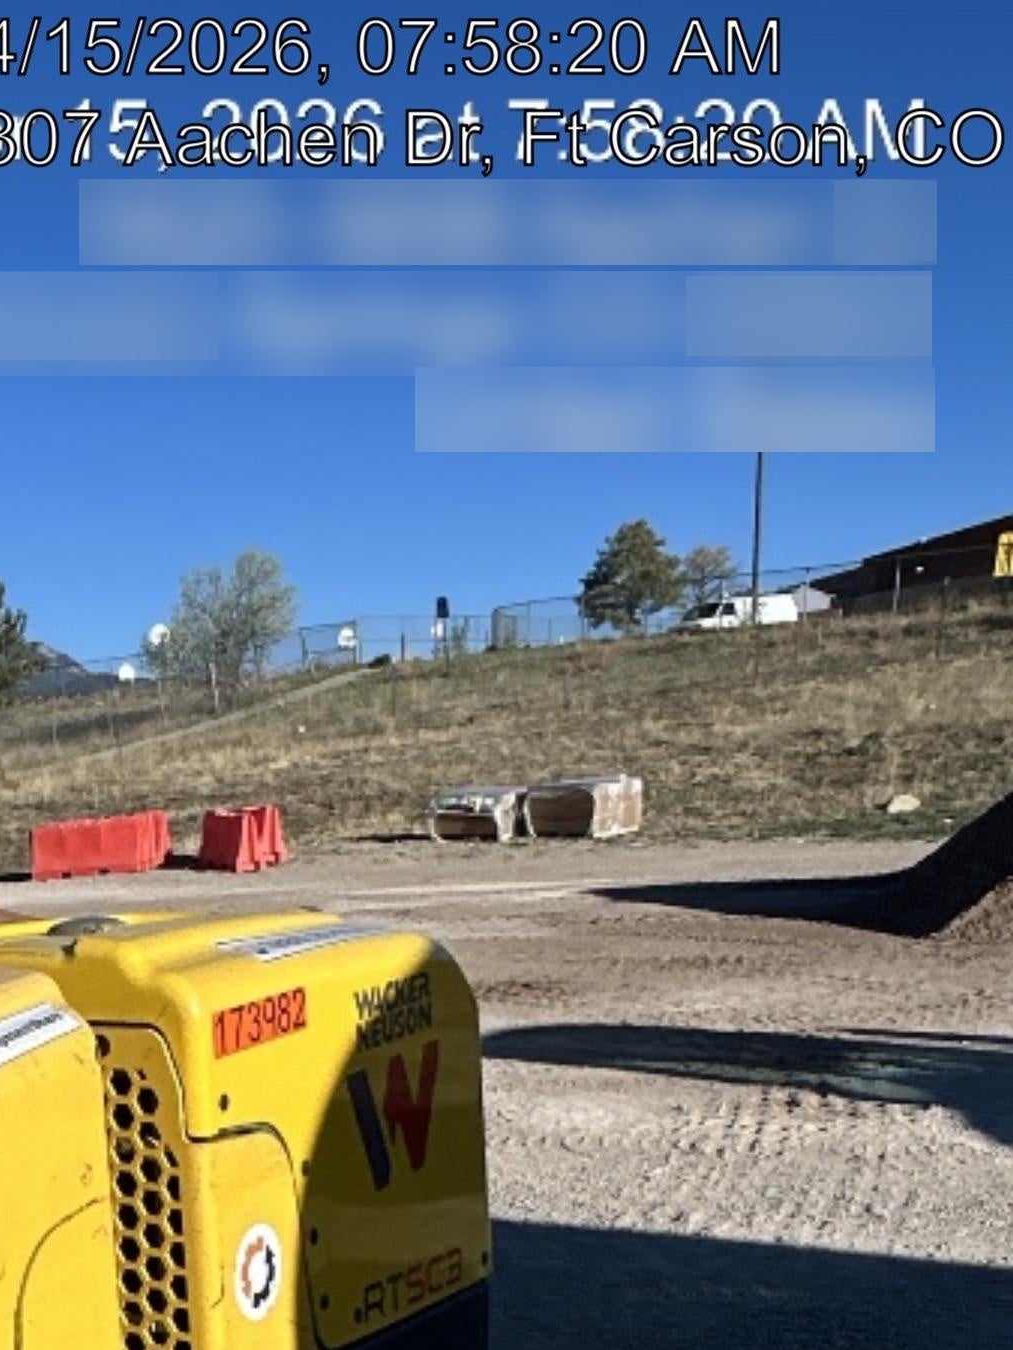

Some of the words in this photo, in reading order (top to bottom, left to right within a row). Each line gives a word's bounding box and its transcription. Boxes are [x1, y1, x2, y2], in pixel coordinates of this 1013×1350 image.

[214, 987, 306, 1056] 173982
[353, 971, 430, 1019] WACKER
[355, 1002, 433, 1050] NEUSON
[364, 1247, 462, 1322] RTSC3
